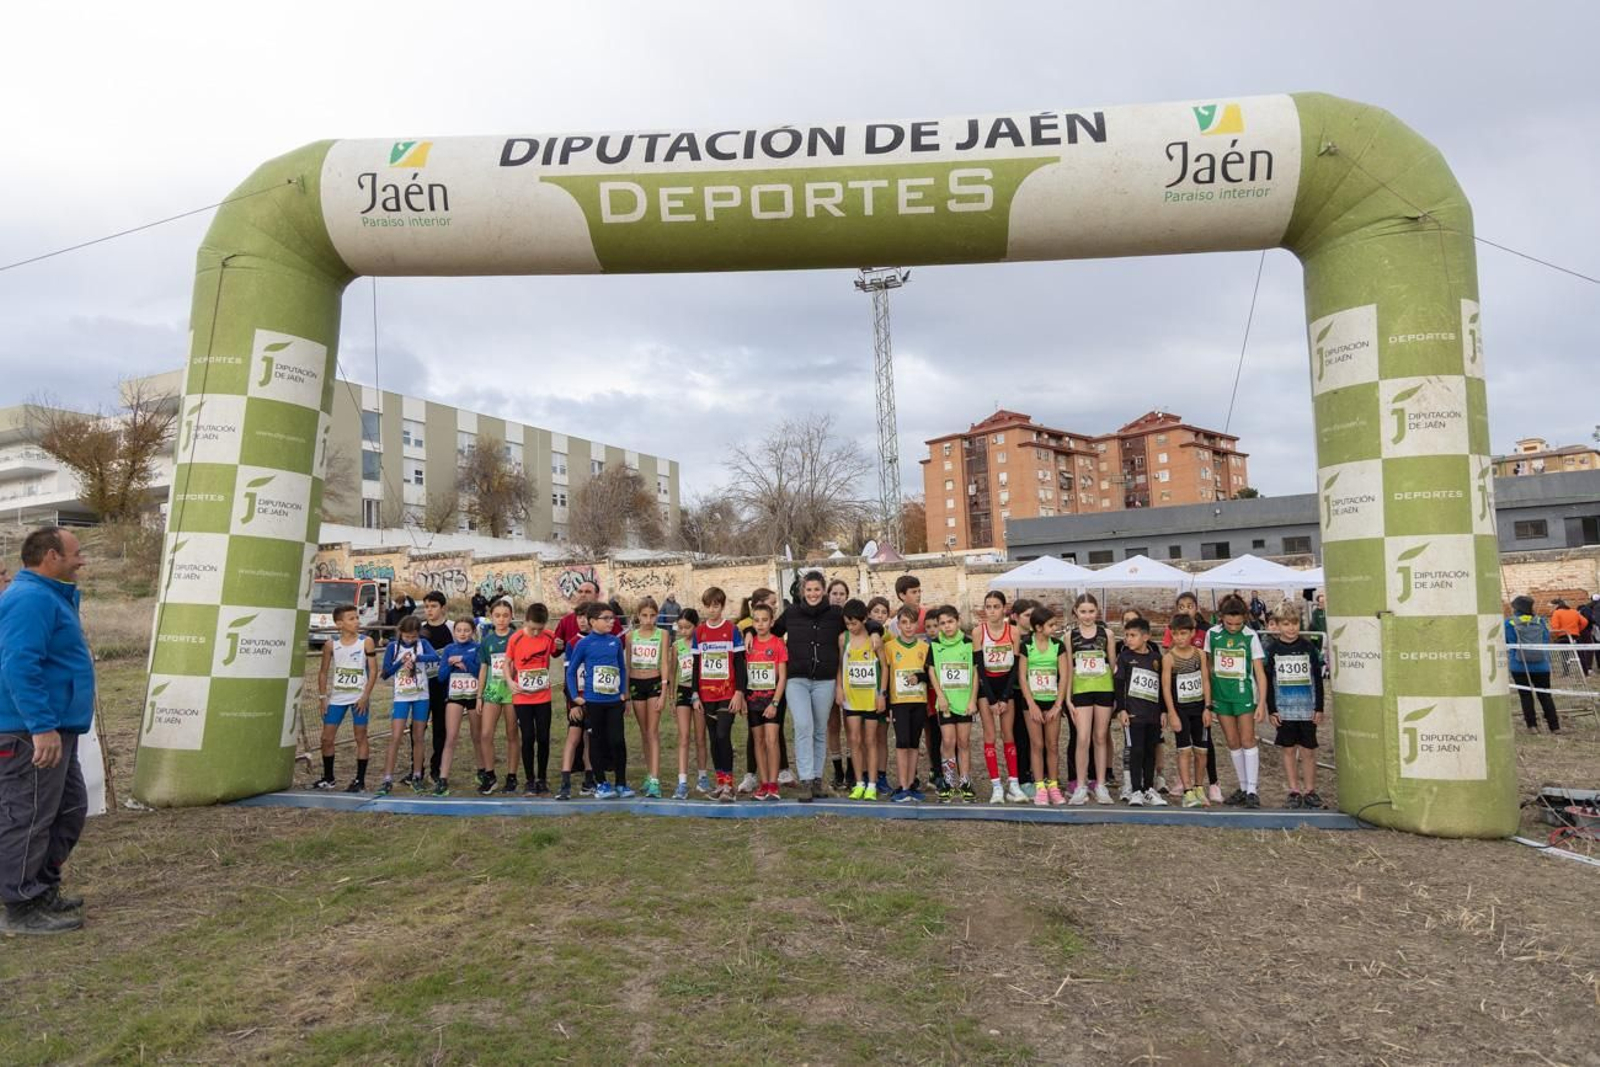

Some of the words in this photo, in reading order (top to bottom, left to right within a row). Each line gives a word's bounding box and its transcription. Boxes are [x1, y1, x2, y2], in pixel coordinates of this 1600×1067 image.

[499, 125, 846, 167] DIPUTACIÓN
[864, 121, 940, 155] DE
[955, 111, 1107, 151] JAÉN
[1165, 139, 1273, 188] Jaén
[357, 172, 450, 214] Jaén
[1219, 186, 1271, 200] interior
[408, 216, 452, 227] interior
[1388, 332, 1456, 344] DEPORTES
[1408, 410, 1462, 420] DIPUTACIÓN
[1408, 422, 1420, 430] DE
[1420, 420, 1446, 430] JAÉN
[1394, 490, 1464, 500] DEPORTES
[1414, 570, 1470, 579] DIPUTACIÓN
[1414, 582, 1427, 590] DE
[1430, 580, 1453, 589] JAÉN
[240, 638, 286, 648] DIPUTACIÓN
[988, 652, 1008, 663] 227
[1400, 651, 1472, 660] DEPORTES
[704, 659, 722, 669] 476
[1082, 657, 1096, 669] 76
[1221, 656, 1234, 668] 59
[849, 667, 874, 678] 4304
[1278, 662, 1308, 674] 4308
[338, 674, 358, 684] 270
[598, 673, 618, 684] 267
[751, 669, 769, 680] 116
[946, 669, 960, 680] 62
[522, 676, 544, 687] 276
[1036, 675, 1050, 686] 81
[1420, 733, 1478, 742] DIPUTACIÓN
[1420, 744, 1434, 752] DE
[1437, 743, 1460, 752] JAÉN
